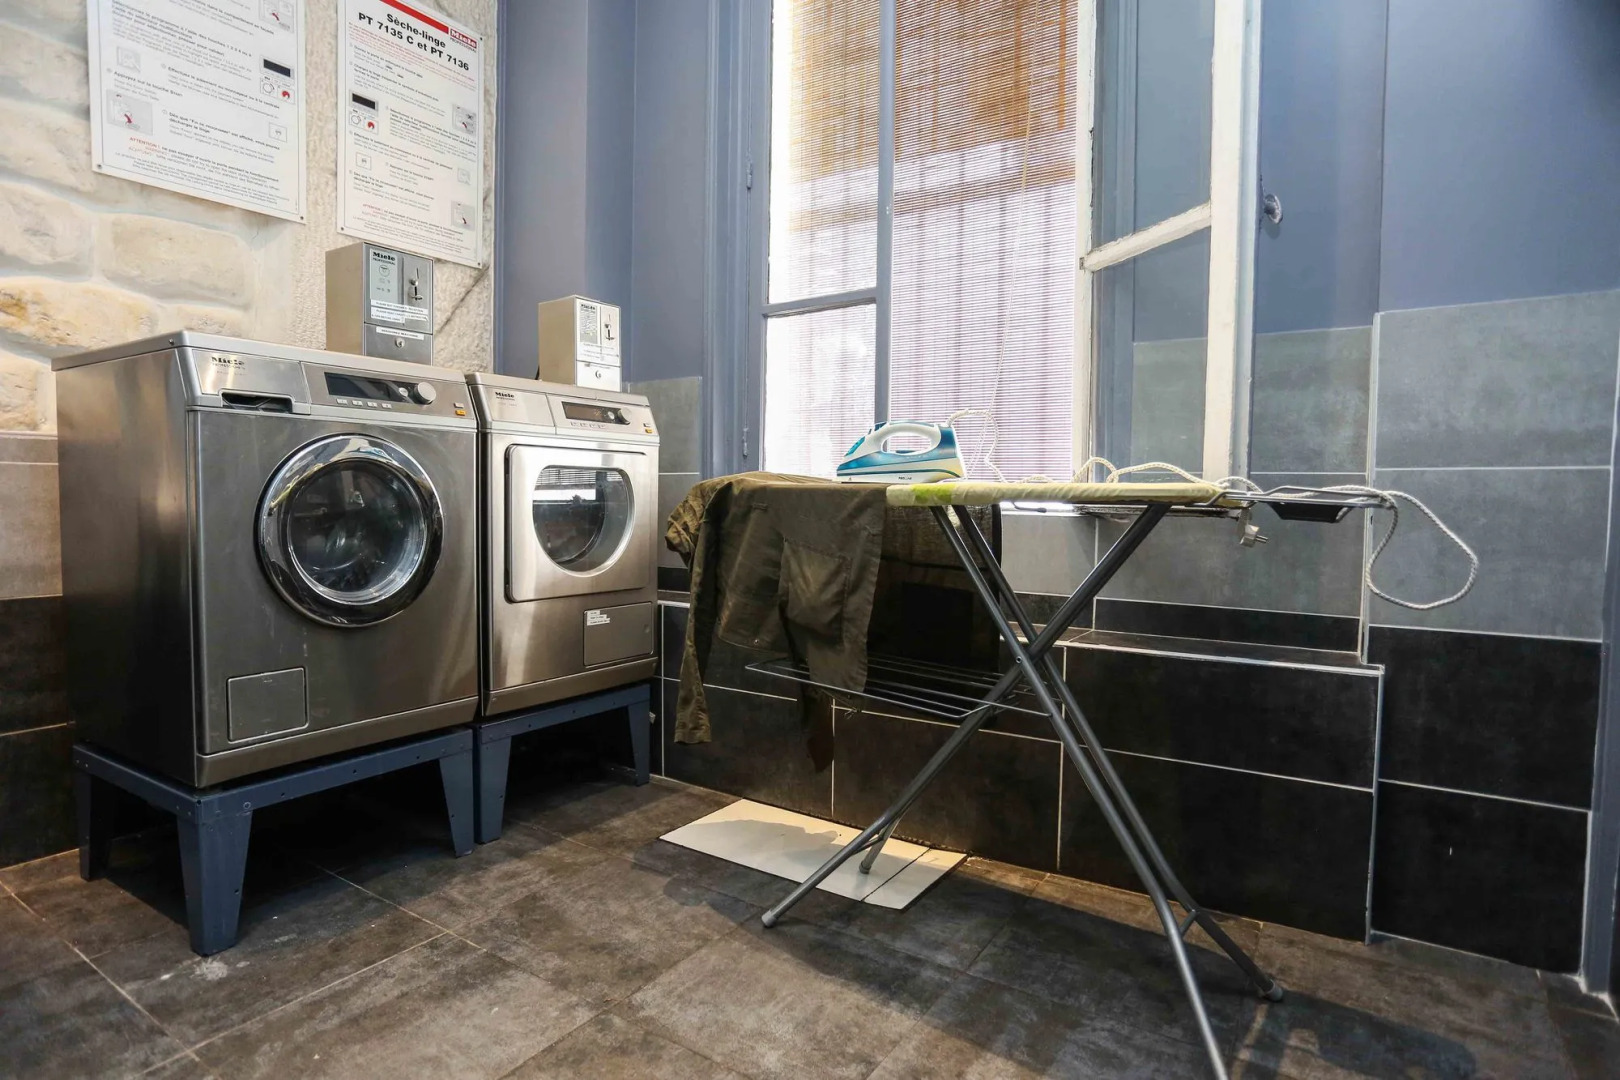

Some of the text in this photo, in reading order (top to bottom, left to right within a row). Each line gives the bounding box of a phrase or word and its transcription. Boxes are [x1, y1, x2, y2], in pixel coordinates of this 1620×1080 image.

[358, 12, 373, 25] PT
[377, 21, 403, 39] 7135
[407, 35, 414, 44] C
[417, 42, 427, 51] et
[430, 47, 443, 58] PT
[447, 54, 469, 70] 7136
[386, 13, 446, 48] Sèche-linge
[451, 30, 476, 47] Miele
[373, 251, 396, 261] Miele
